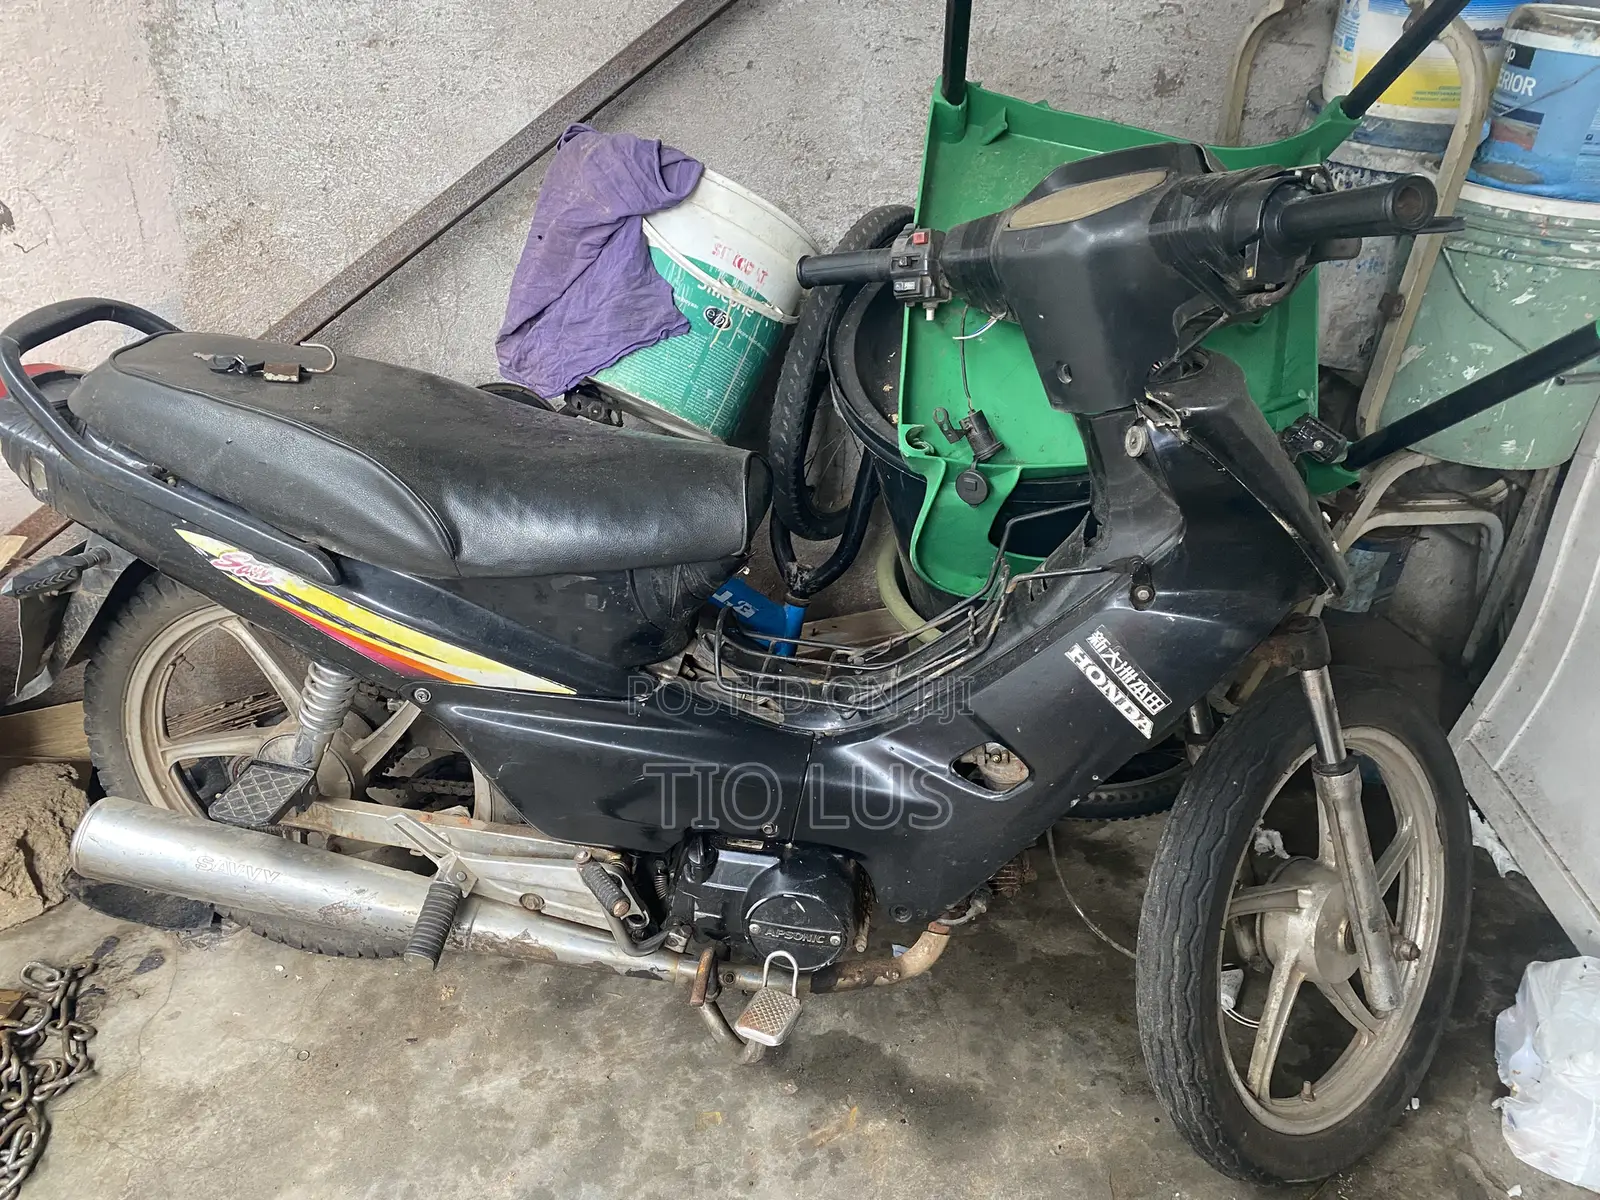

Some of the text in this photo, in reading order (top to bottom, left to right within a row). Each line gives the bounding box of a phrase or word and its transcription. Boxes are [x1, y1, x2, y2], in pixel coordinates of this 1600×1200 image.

[1065, 644, 1153, 738] HONDA
[195, 855, 281, 884] SAVVY
[764, 928, 826, 944] APSONIC
